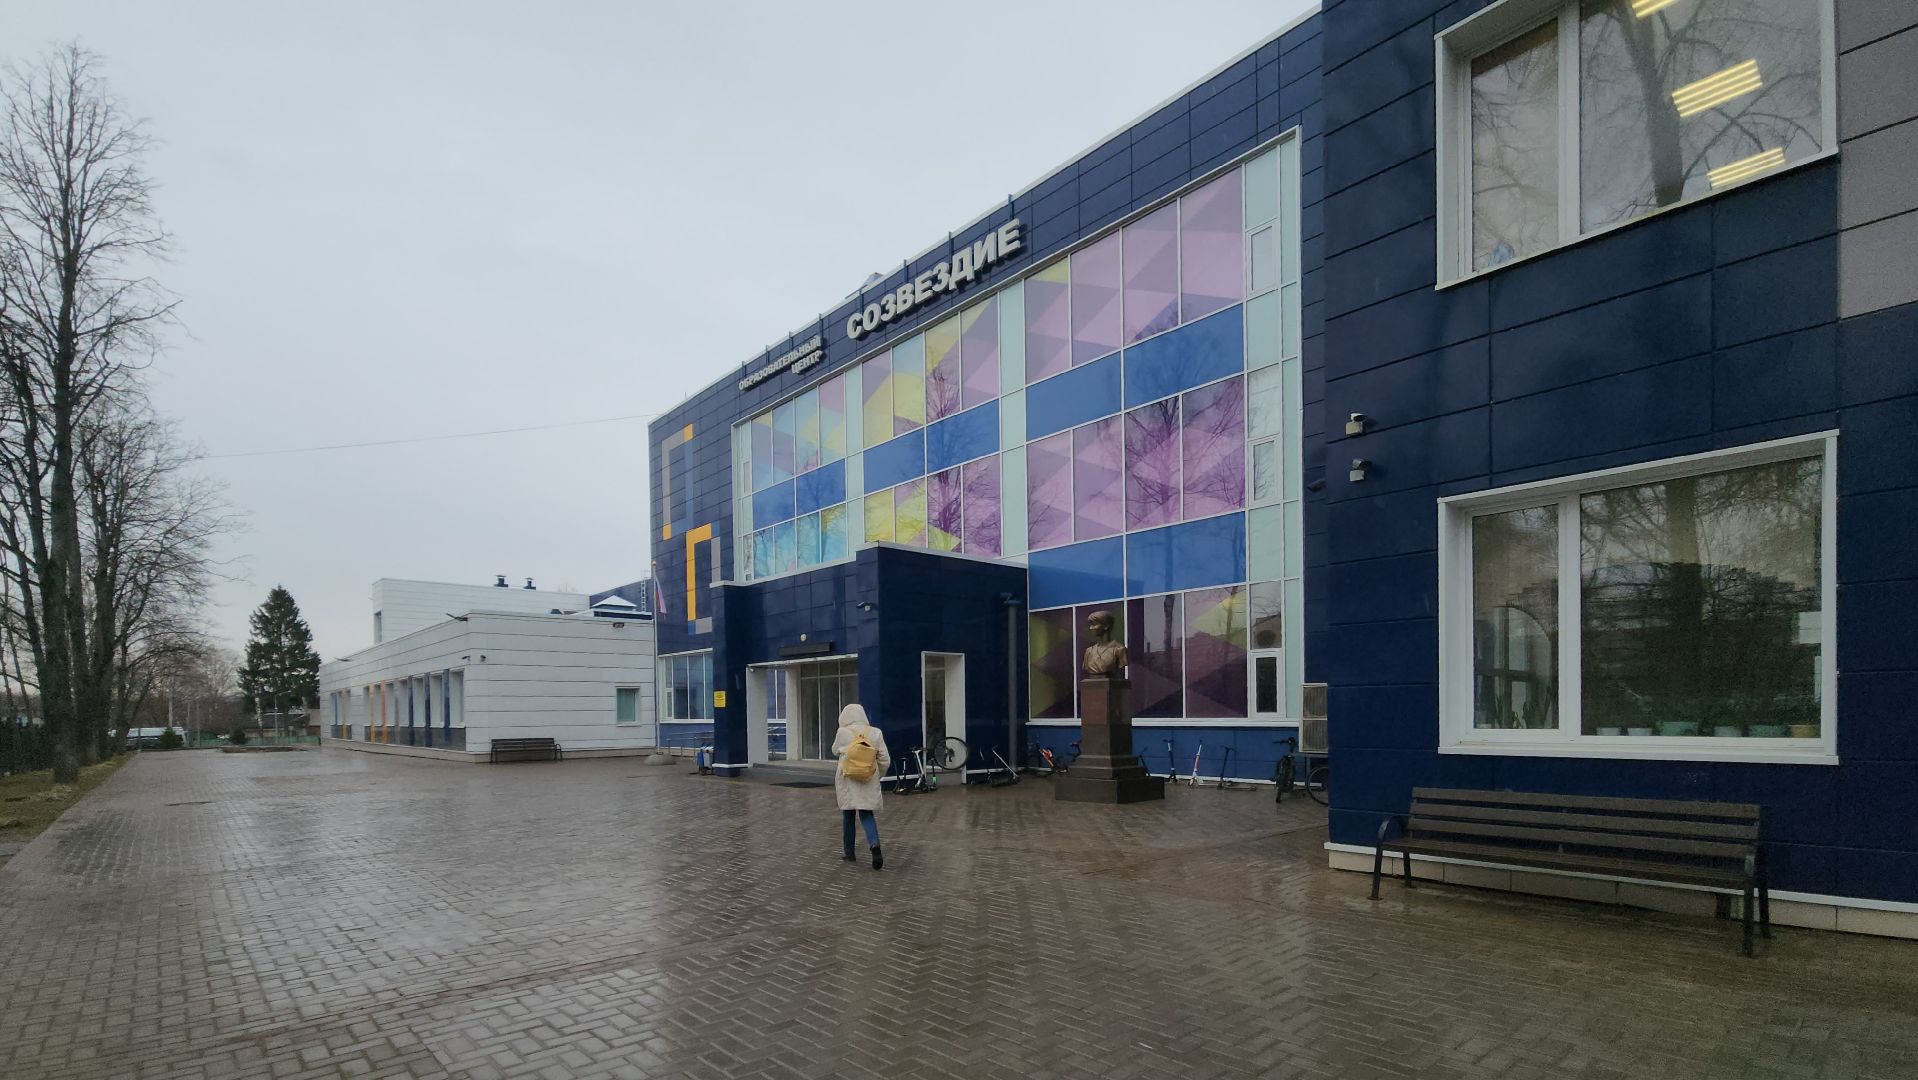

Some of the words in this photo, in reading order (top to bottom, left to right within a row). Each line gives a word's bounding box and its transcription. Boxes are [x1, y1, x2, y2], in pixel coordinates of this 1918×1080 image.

[846, 218, 1021, 340] СОЗВЕЗДИЕ
[739, 334, 821, 390] ОБРАЗОВАТЕЛЬНЫЙ
[791, 350, 823, 374] ЦЕНТР
